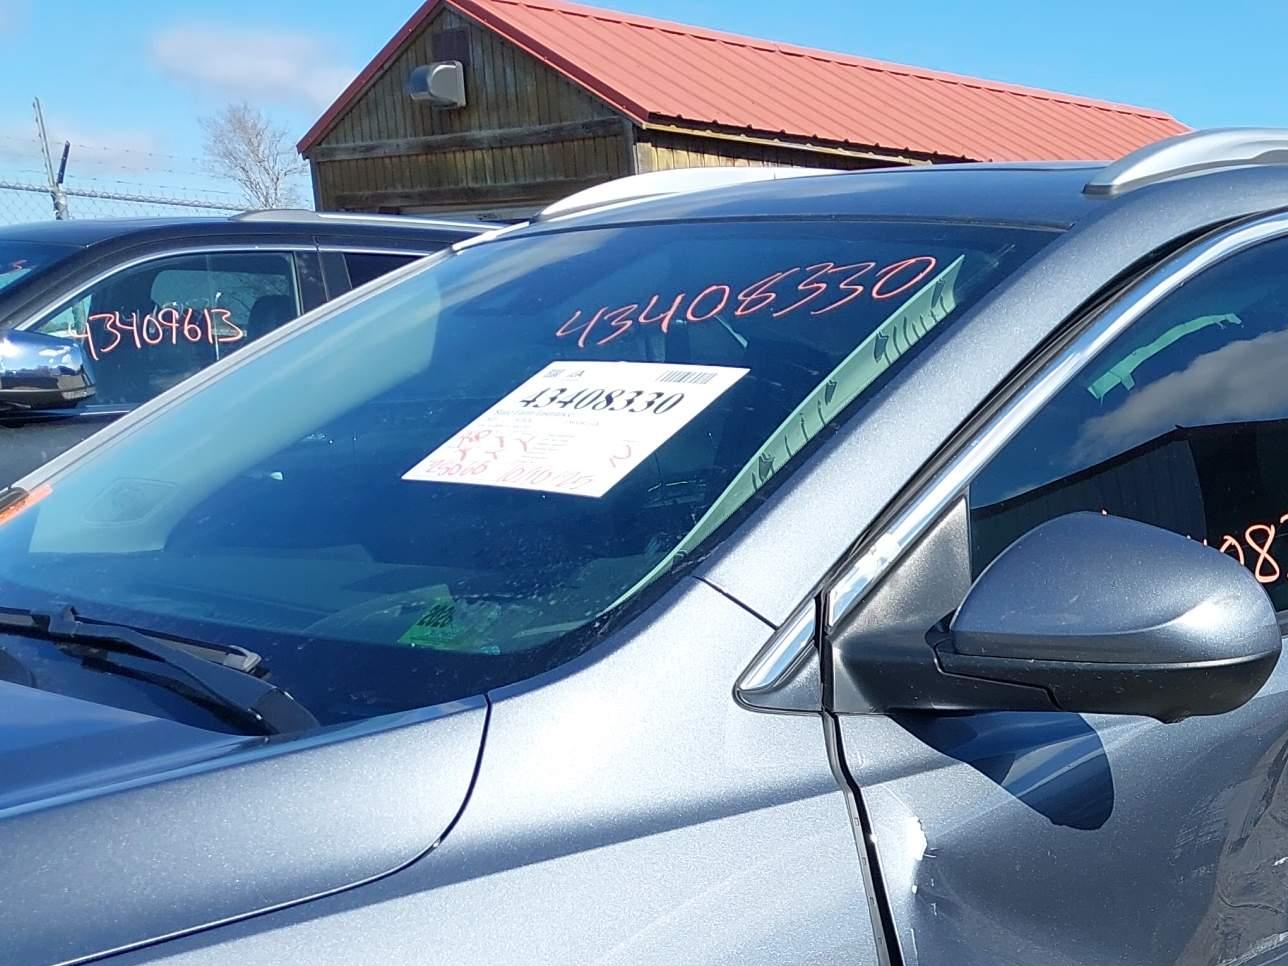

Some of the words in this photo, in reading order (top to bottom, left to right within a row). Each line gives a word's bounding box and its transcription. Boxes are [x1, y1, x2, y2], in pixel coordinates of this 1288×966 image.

[556, 256, 938, 348] 43408330
[69, 307, 243, 360] 43409613
[519, 387, 686, 416] 43408330
